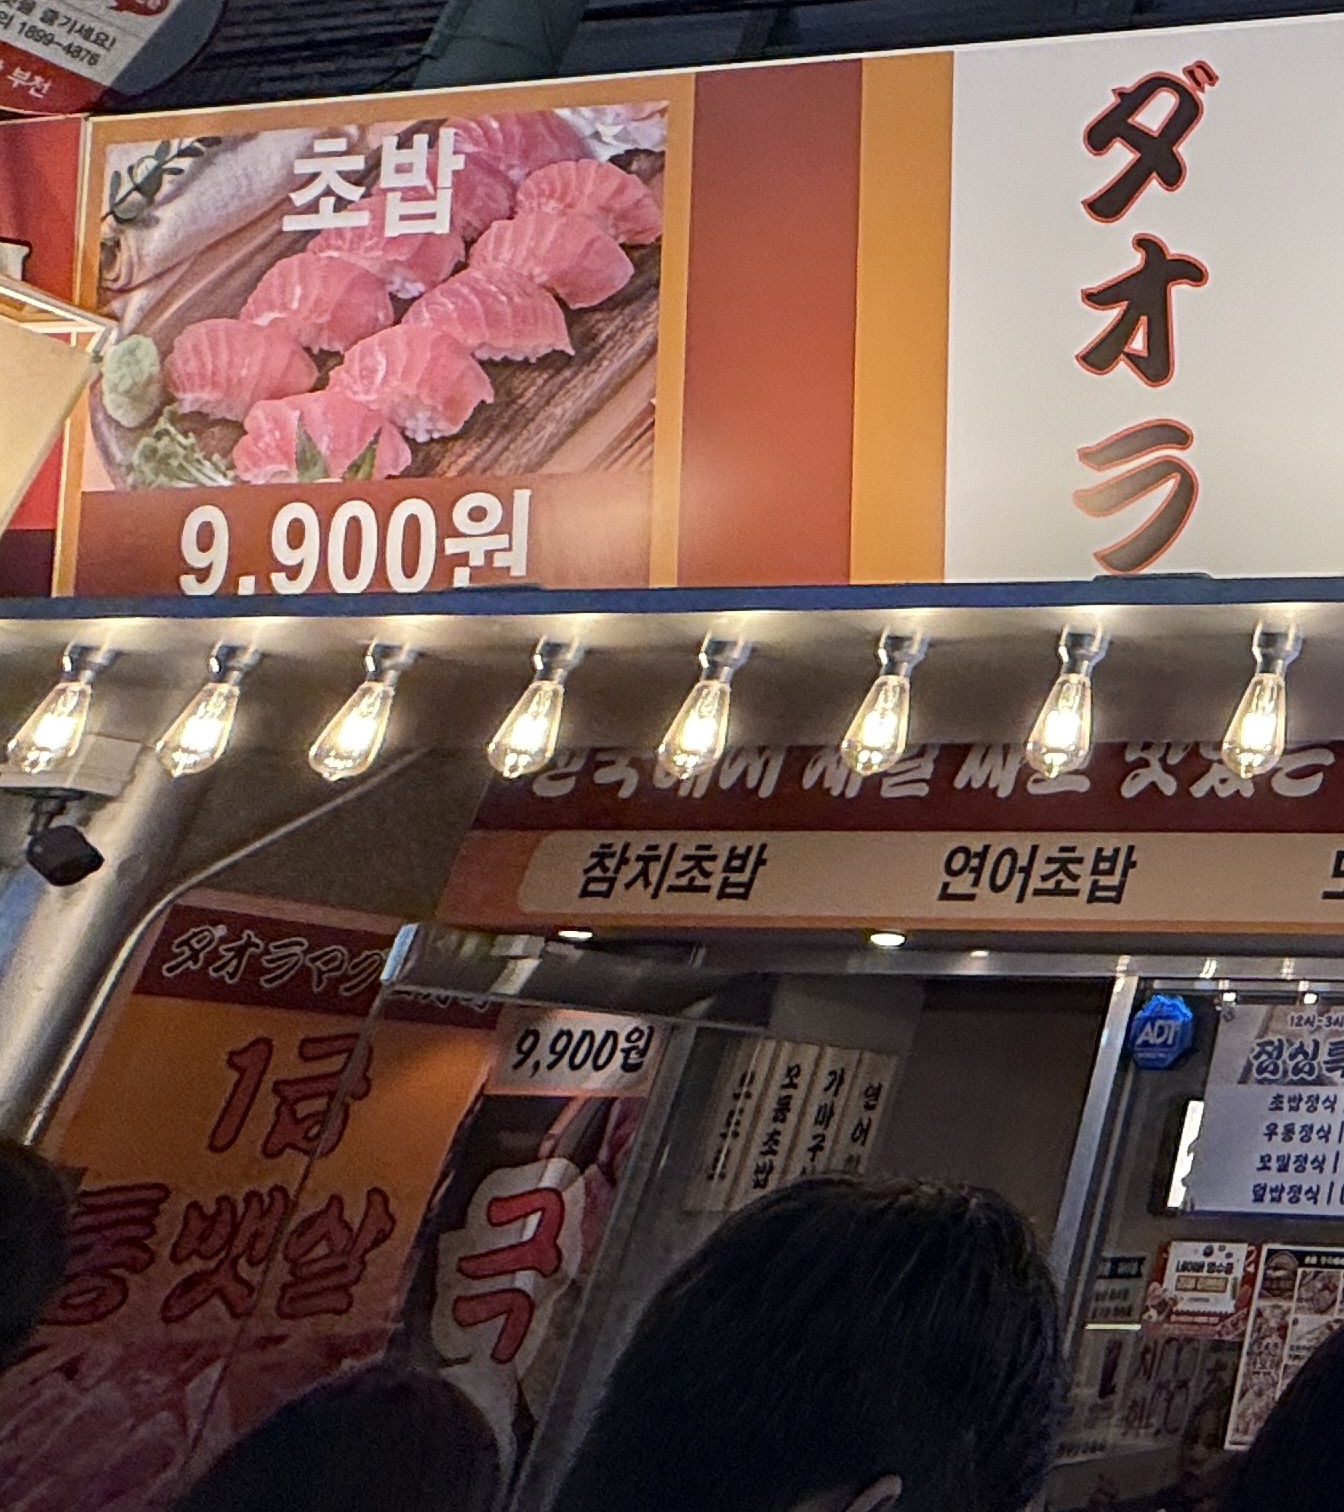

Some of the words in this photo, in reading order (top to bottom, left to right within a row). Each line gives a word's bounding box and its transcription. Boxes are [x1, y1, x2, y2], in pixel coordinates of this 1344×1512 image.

[281, 126, 466, 238] 초밥
[1073, 60, 1219, 574] ダオラ
[578, 841, 768, 901] 참치초밥
[936, 843, 1137, 905] 연어초밥
[511, 1023, 655, 1076] 9,900원
[1134, 1019, 1182, 1046] ADT
[206, 1035, 374, 1160] 1급
[800, 1066, 846, 1177] 가마구
[1267, 1092, 1338, 1115] 초밥정식
[1262, 1122, 1332, 1144] 우동정식
